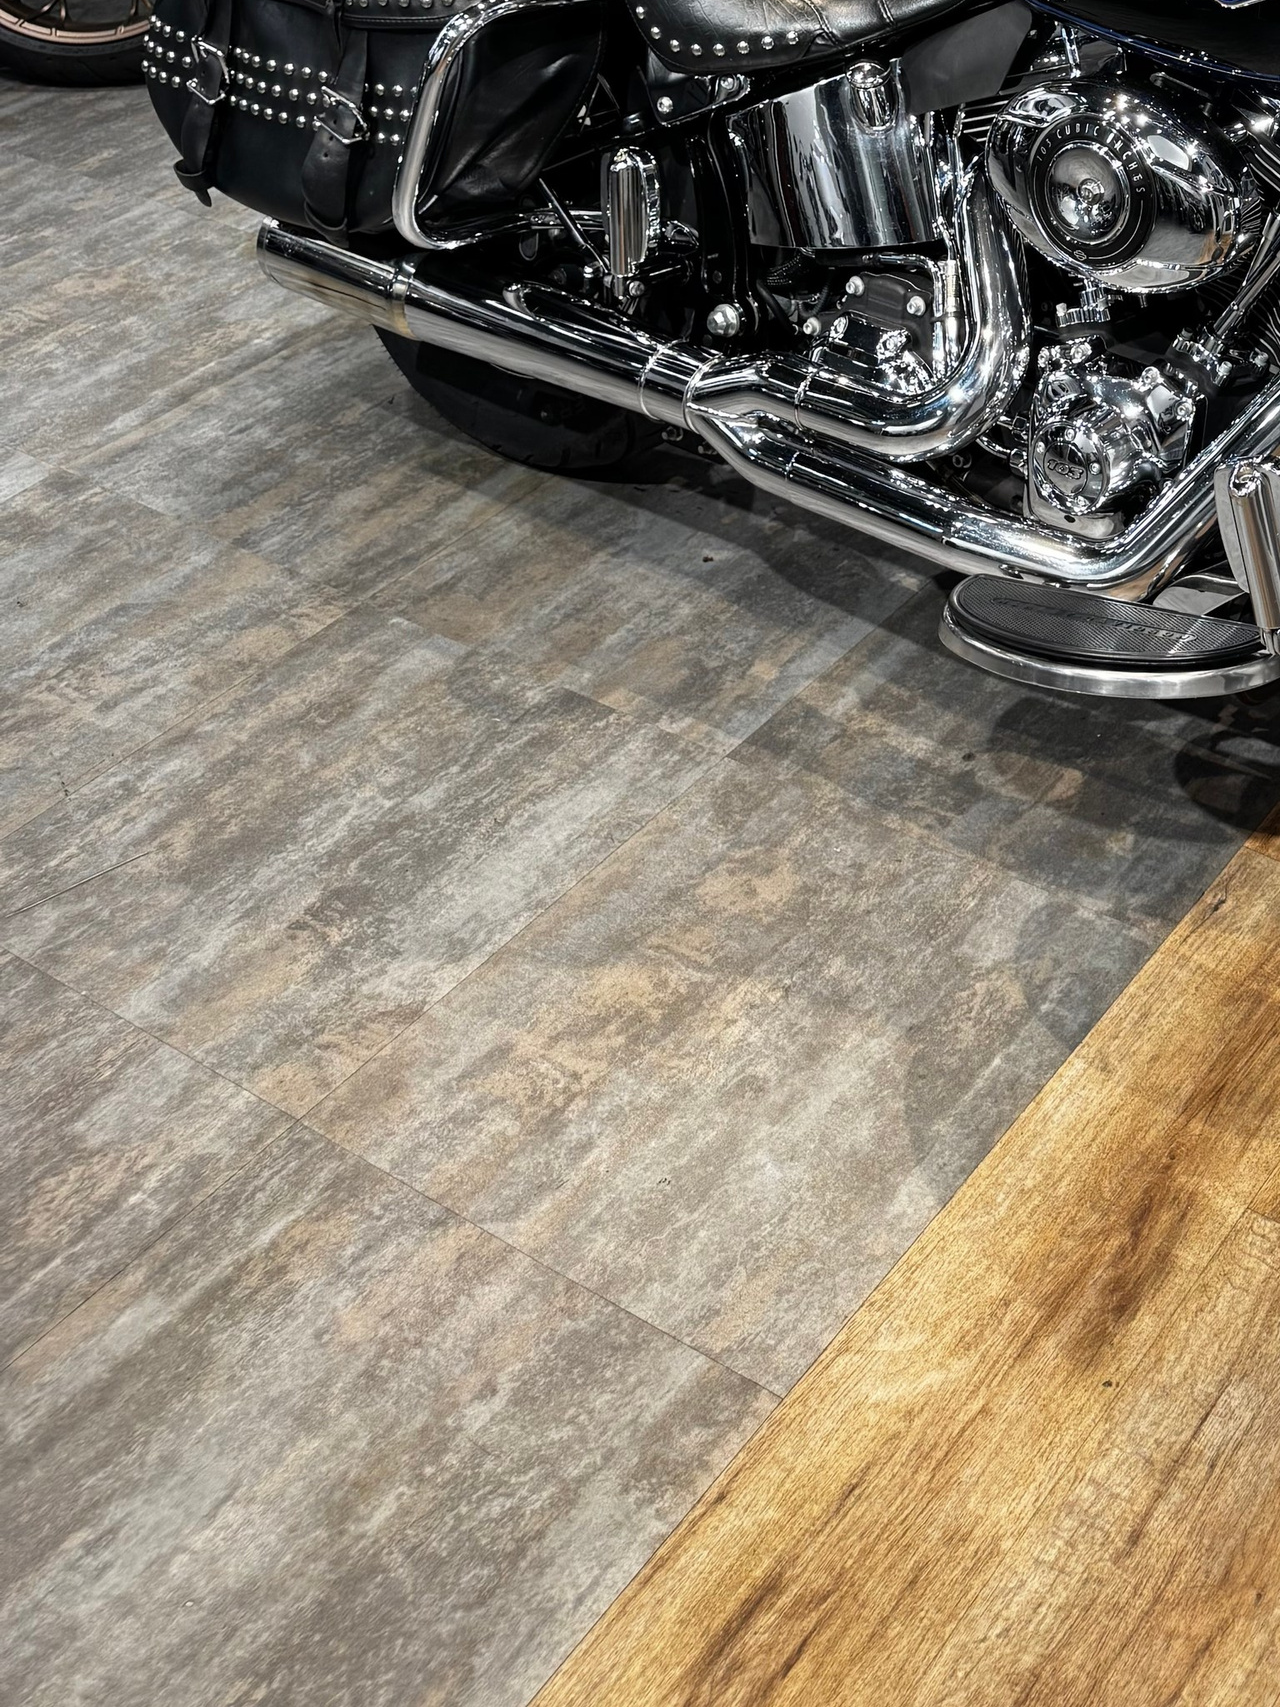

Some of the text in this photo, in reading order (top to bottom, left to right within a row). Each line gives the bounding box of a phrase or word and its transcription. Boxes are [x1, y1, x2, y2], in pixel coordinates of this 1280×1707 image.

[1036, 123, 1146, 194] 103 CUBIC INCHES
[1047, 458, 1084, 480] 103
